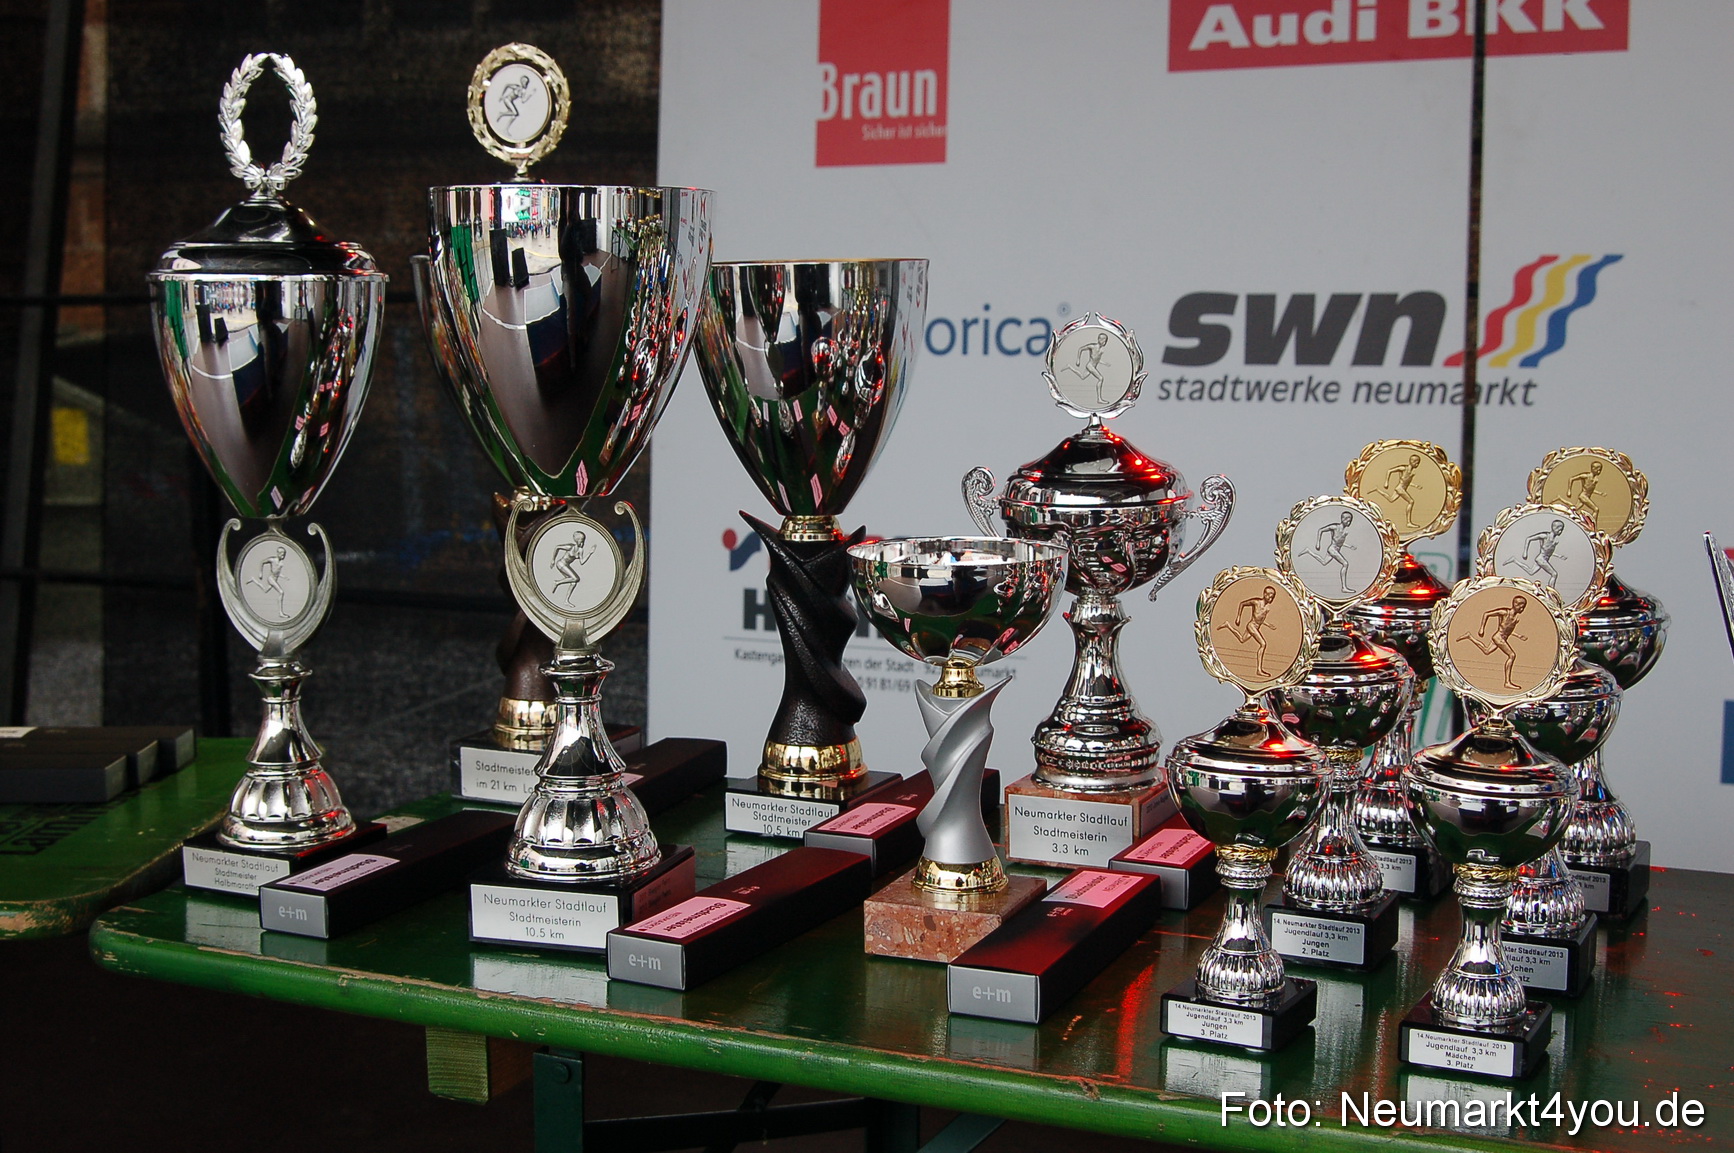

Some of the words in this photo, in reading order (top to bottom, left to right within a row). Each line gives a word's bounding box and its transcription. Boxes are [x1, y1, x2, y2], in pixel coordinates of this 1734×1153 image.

[1188, 0, 1377, 51] Audi
[1407, 0, 1605, 39] BKK
[817, 61, 938, 121] Braun
[925, 303, 1052, 356] orica
[1161, 290, 1447, 368] swn
[1158, 375, 1340, 403] stadtwerke
[1353, 377, 1537, 406] neumarkt
[475, 760, 534, 776] Stadtmeister
[476, 779, 487, 788] im
[490, 780, 500, 790] 21
[503, 781, 517, 791] km
[523, 783, 533, 794] La
[732, 798, 788, 814] Neumarkter
[790, 804, 834, 818] Stadtlauf
[753, 811, 811, 827] Stadtmeister
[1014, 806, 1077, 822] Neumarkter
[1080, 812, 1128, 827] Stadtlauf
[786, 827, 800, 838] km
[1033, 826, 1108, 843] Stadtmeisterin
[1051, 843, 1069, 854] 3.3
[1074, 844, 1089, 856] km
[192, 852, 239, 867] Neumarkter
[241, 859, 279, 873] Stadtlauf
[214, 867, 257, 880] Stadtmeister
[483, 893, 552, 909] Neumarkter
[555, 899, 607, 913] Stadtlauf
[278, 907, 307, 922] e+m
[509, 911, 582, 927] Stadtmeisterin
[550, 929, 565, 940] km
[1283, 920, 1317, 929] Neumarkter
[1318, 923, 1345, 932] Stadtlauf
[1346, 927, 1360, 935] 2013
[1284, 927, 1323, 938] Jugendlauf
[1302, 939, 1330, 948] Jungen
[1518, 946, 1547, 956] Stadtlauf
[1311, 949, 1330, 957] Platz
[628, 953, 661, 971] e+m
[972, 986, 1011, 1003] e+m
[1186, 1011, 1221, 1022] Jugendlauf
[1215, 1010, 1240, 1018] Stadtlauf
[1202, 1021, 1228, 1030] Jungen
[1210, 1030, 1228, 1039] Platz
[1426, 1041, 1468, 1053] Jugendlauf
[1485, 1049, 1497, 1057] km
[1462, 1039, 1489, 1048] Stadtlauf
[1445, 1051, 1476, 1061] Mädchen
[1455, 1061, 1474, 1069] Platz
